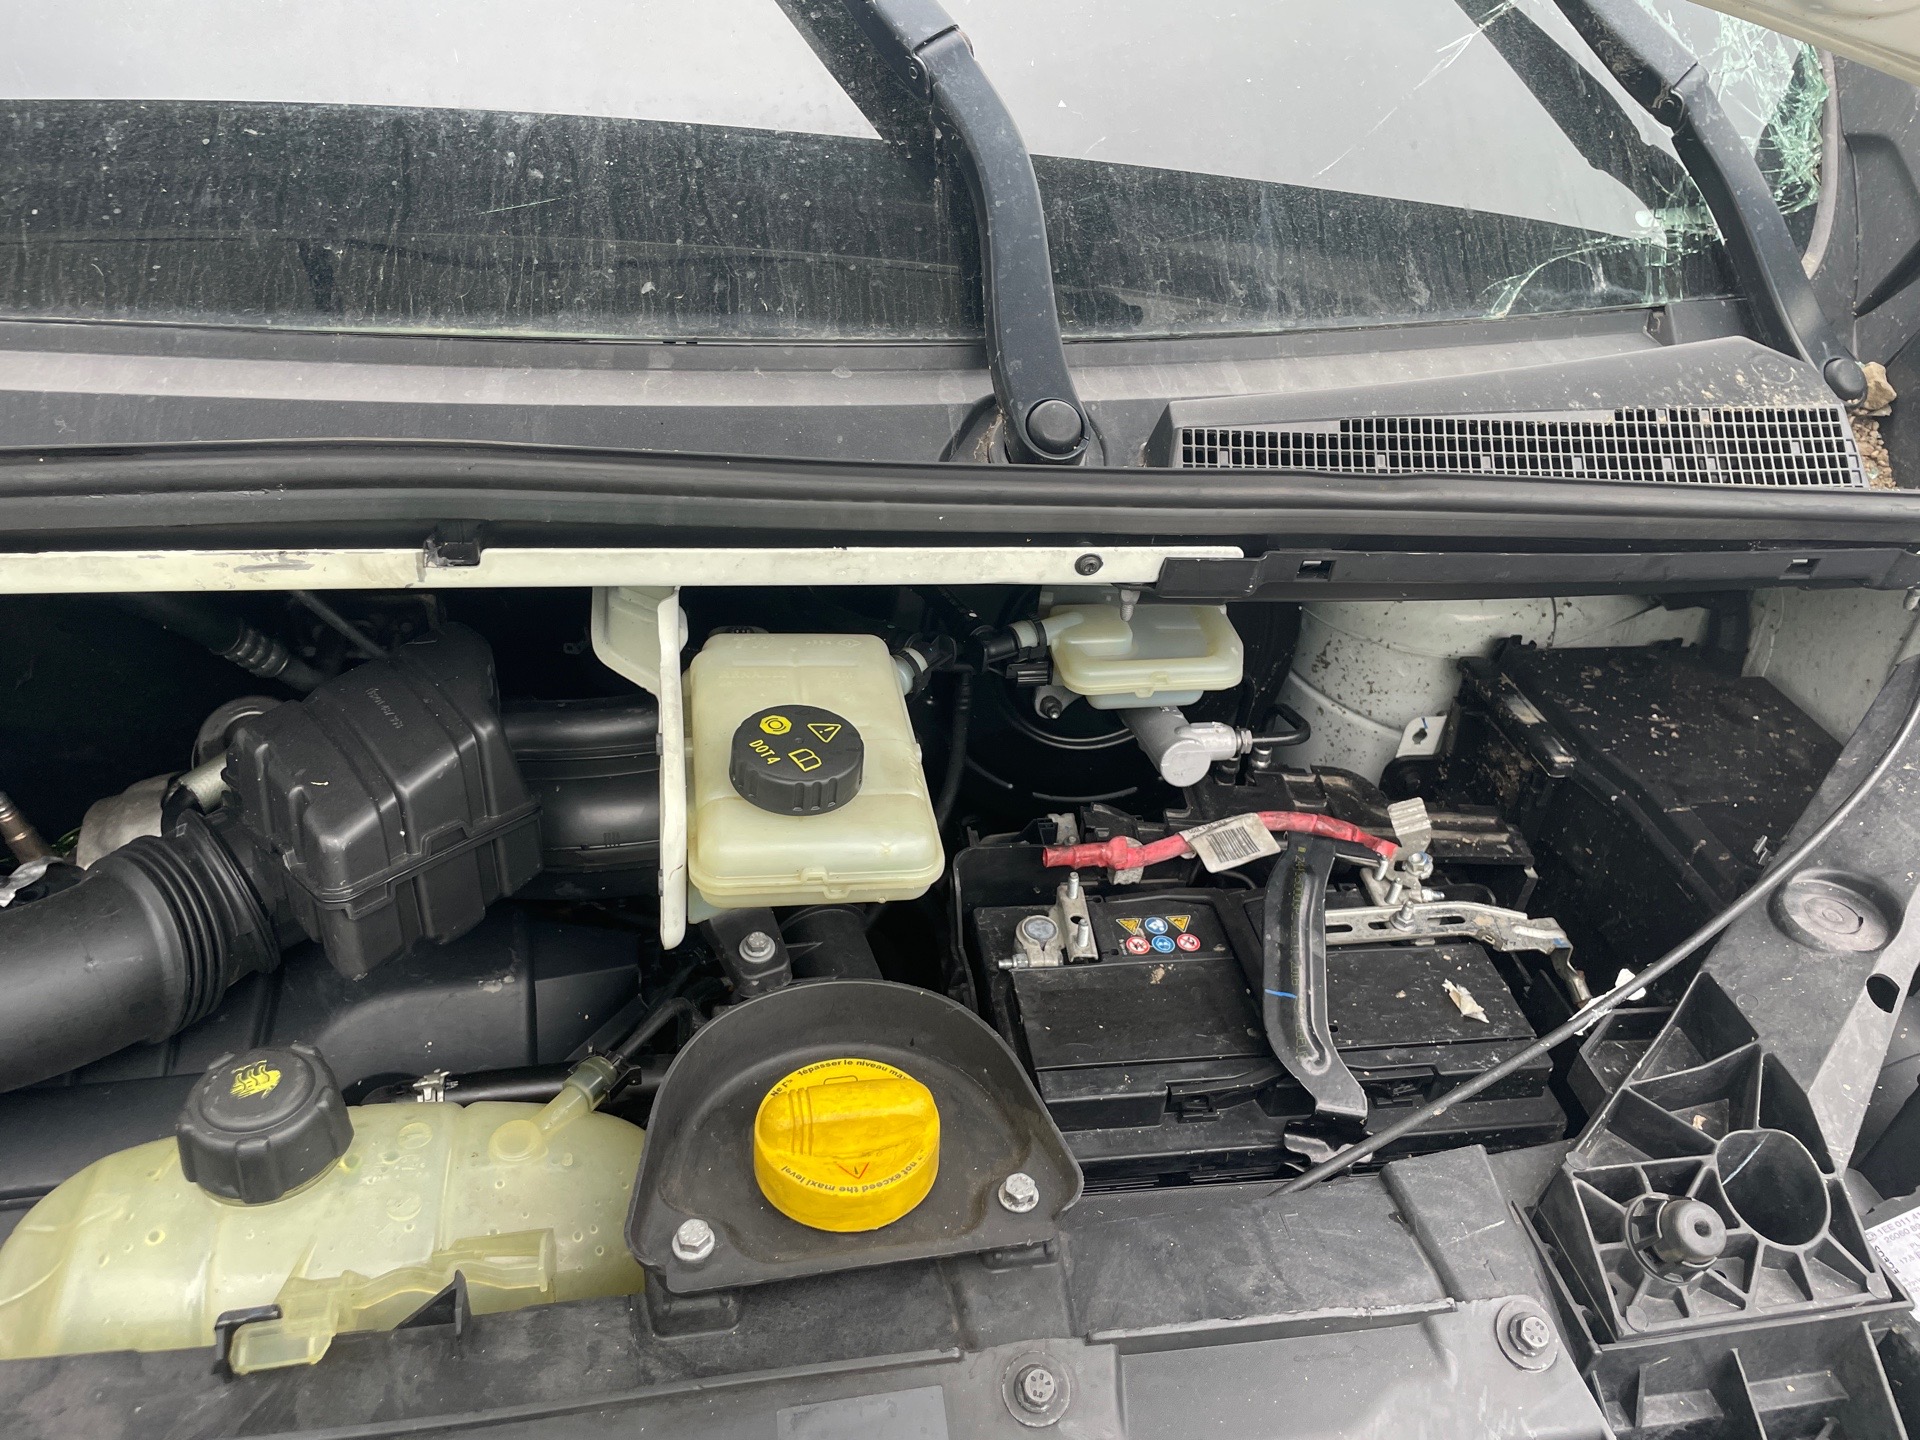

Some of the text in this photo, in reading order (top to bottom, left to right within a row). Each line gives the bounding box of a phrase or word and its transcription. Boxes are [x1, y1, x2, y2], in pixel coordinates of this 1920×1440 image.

[856, 1061, 888, 1072] niveau
[889, 1069, 909, 1080] ma
[781, 1165, 806, 1183] level
[862, 1173, 901, 1193] exceed
[806, 1179, 835, 1191] maxi
